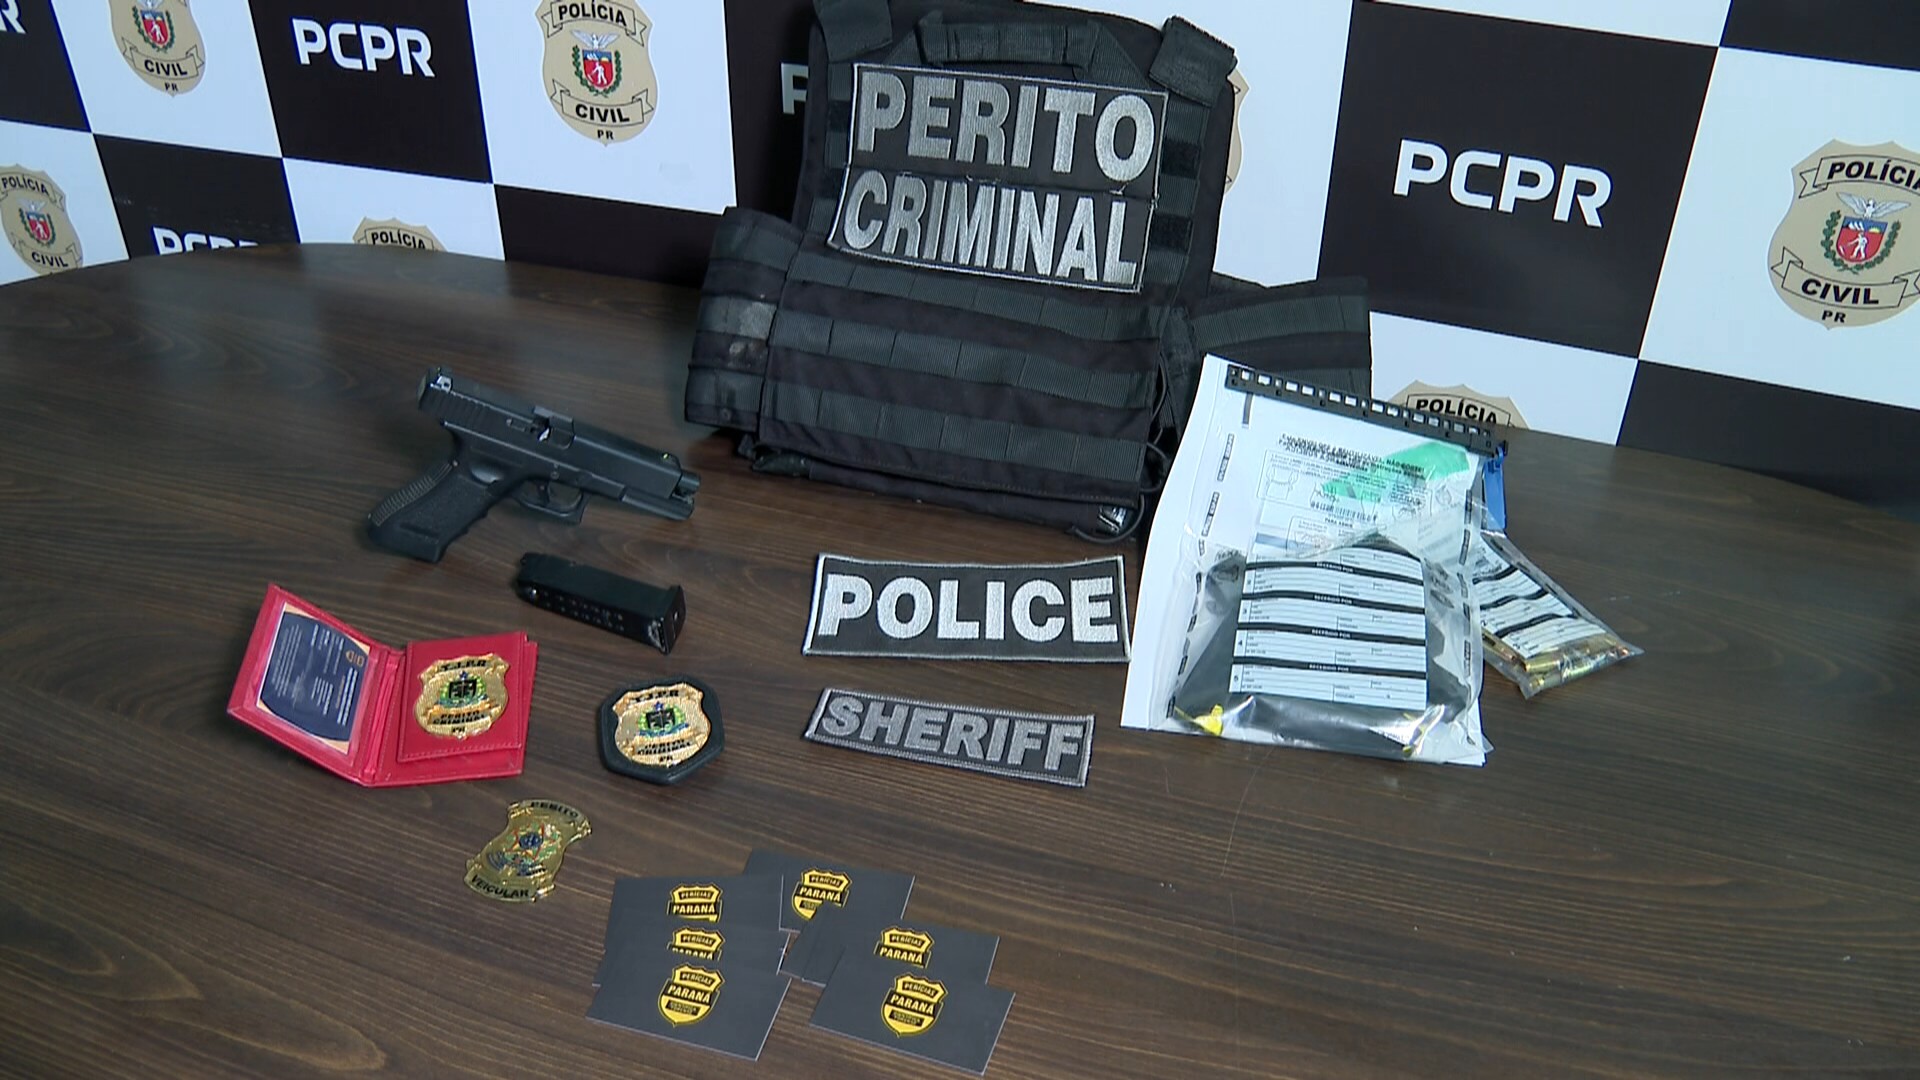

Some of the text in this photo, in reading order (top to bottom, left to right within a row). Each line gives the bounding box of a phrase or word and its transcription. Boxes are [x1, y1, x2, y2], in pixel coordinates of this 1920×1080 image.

[558, 0, 627, 26] POLÍCIA
[292, 18, 435, 77] PCPR
[144, 59, 188, 76] CIVIL
[164, 82, 178, 91] PR
[575, 104, 630, 123] CIVIL
[597, 129, 614, 140] PR
[857, 72, 1155, 182] PERITO
[2, 174, 50, 197] POLÍCIA
[1393, 139, 1611, 228] PCPR
[371, 229, 426, 249] POLÍCIA
[842, 169, 1138, 285] CRIMINAL
[32, 251, 69, 268] CIVIL
[1801, 278, 1879, 304] CIVIL
[1821, 310, 1846, 323] PR
[1416, 398, 1497, 424] POLÍCIA
[818, 573, 1119, 643] POLICE
[822, 696, 1084, 771] SHERIFF
[531, 801, 579, 819] PERITO
[471, 874, 529, 899] VEICULAR
